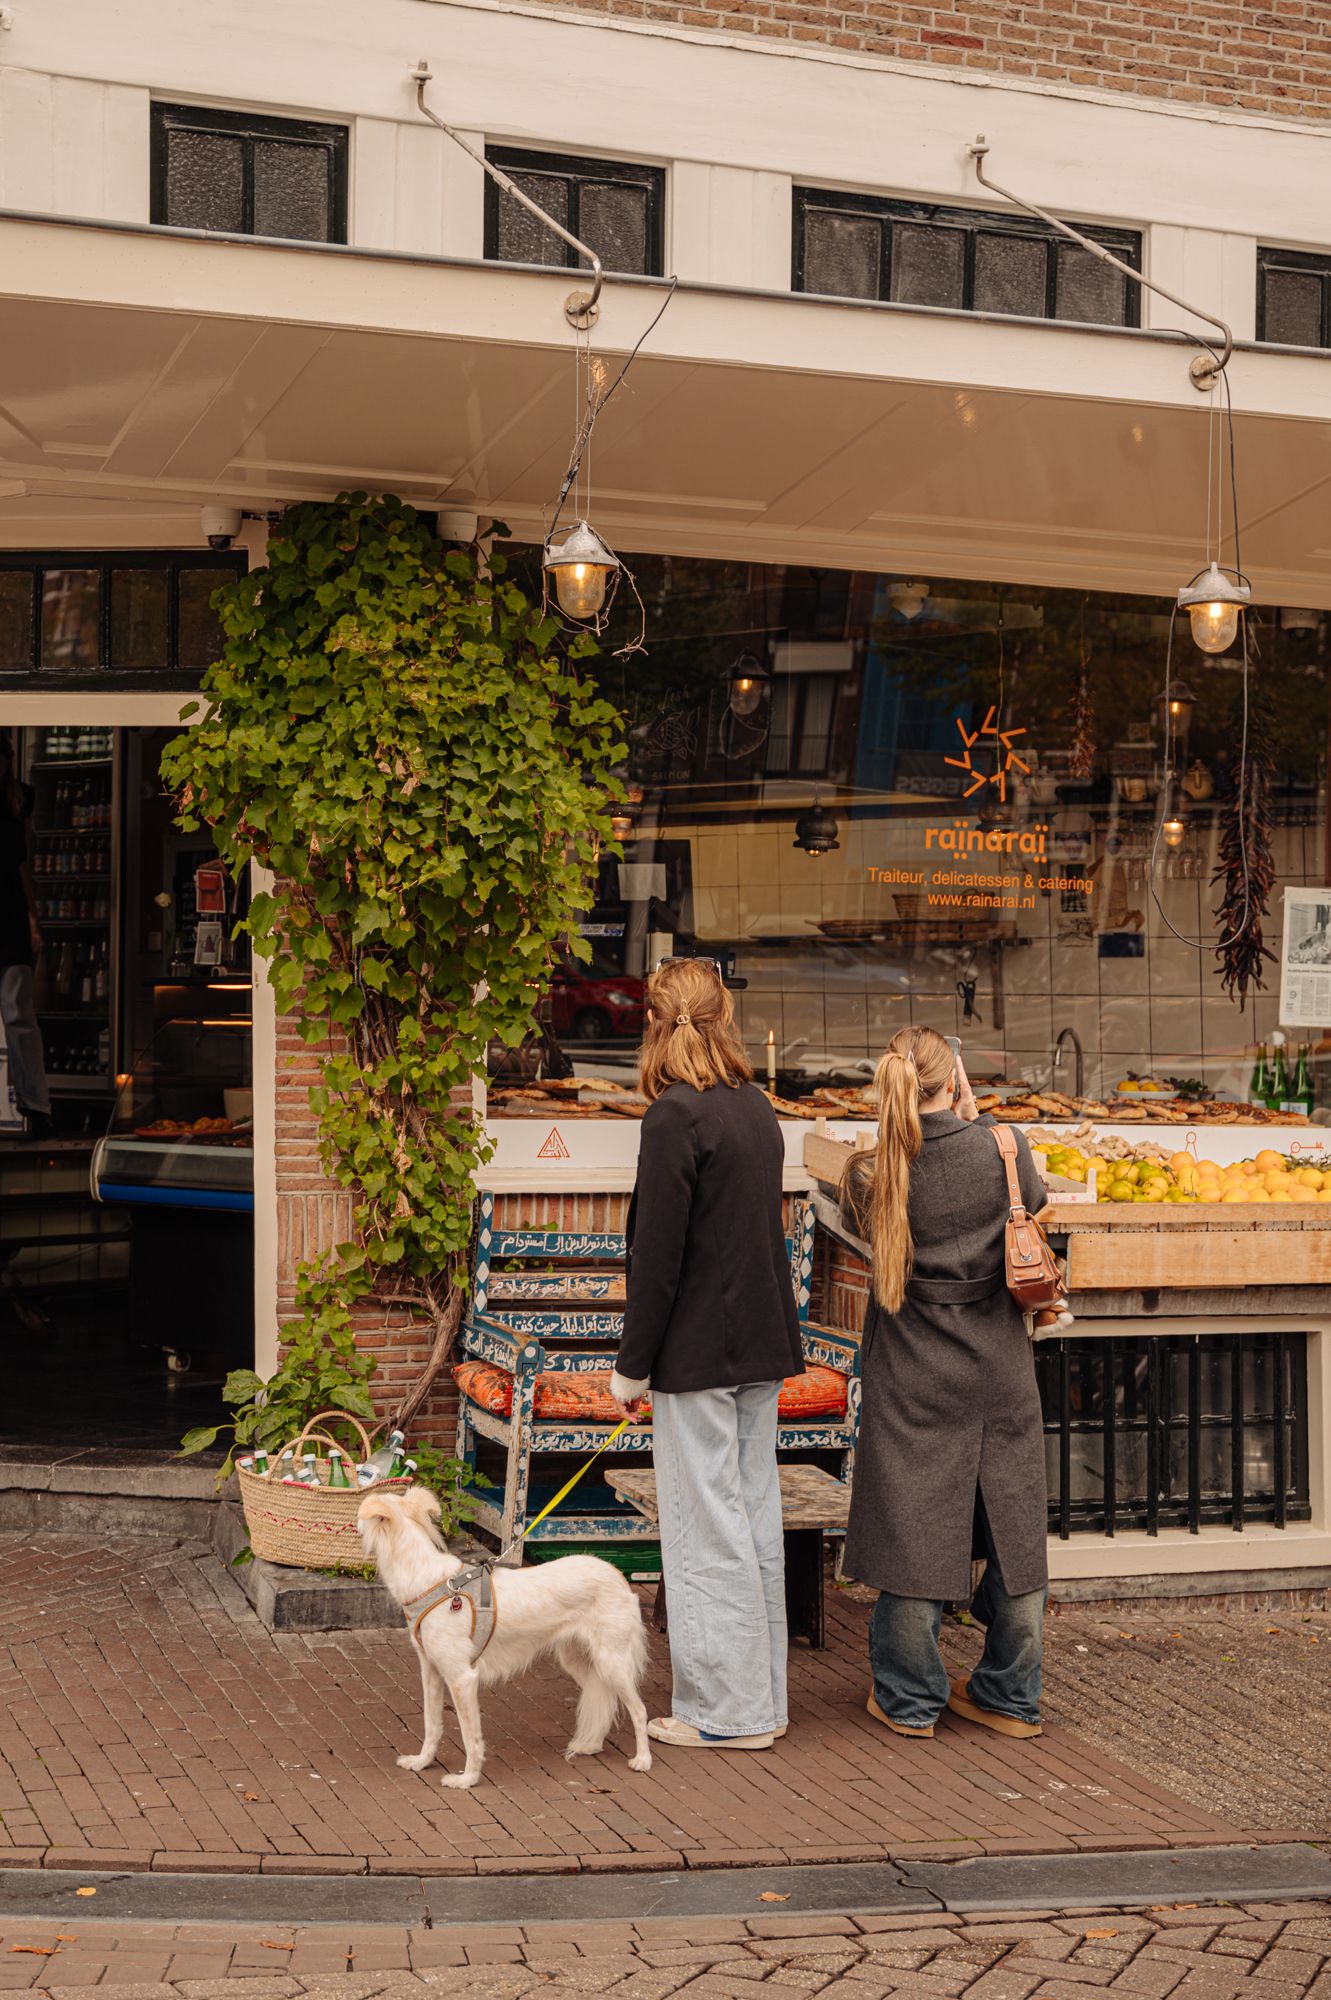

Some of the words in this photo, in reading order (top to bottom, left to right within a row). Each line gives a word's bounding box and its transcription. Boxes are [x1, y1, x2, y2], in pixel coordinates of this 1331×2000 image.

[867, 867, 928, 887] Traiteur,
[931, 870, 1020, 889] delicatessen
[1023, 873, 1034, 889] &
[1038, 875, 1094, 895] catering
[927, 893, 1036, 909] www.rainarai.nl
